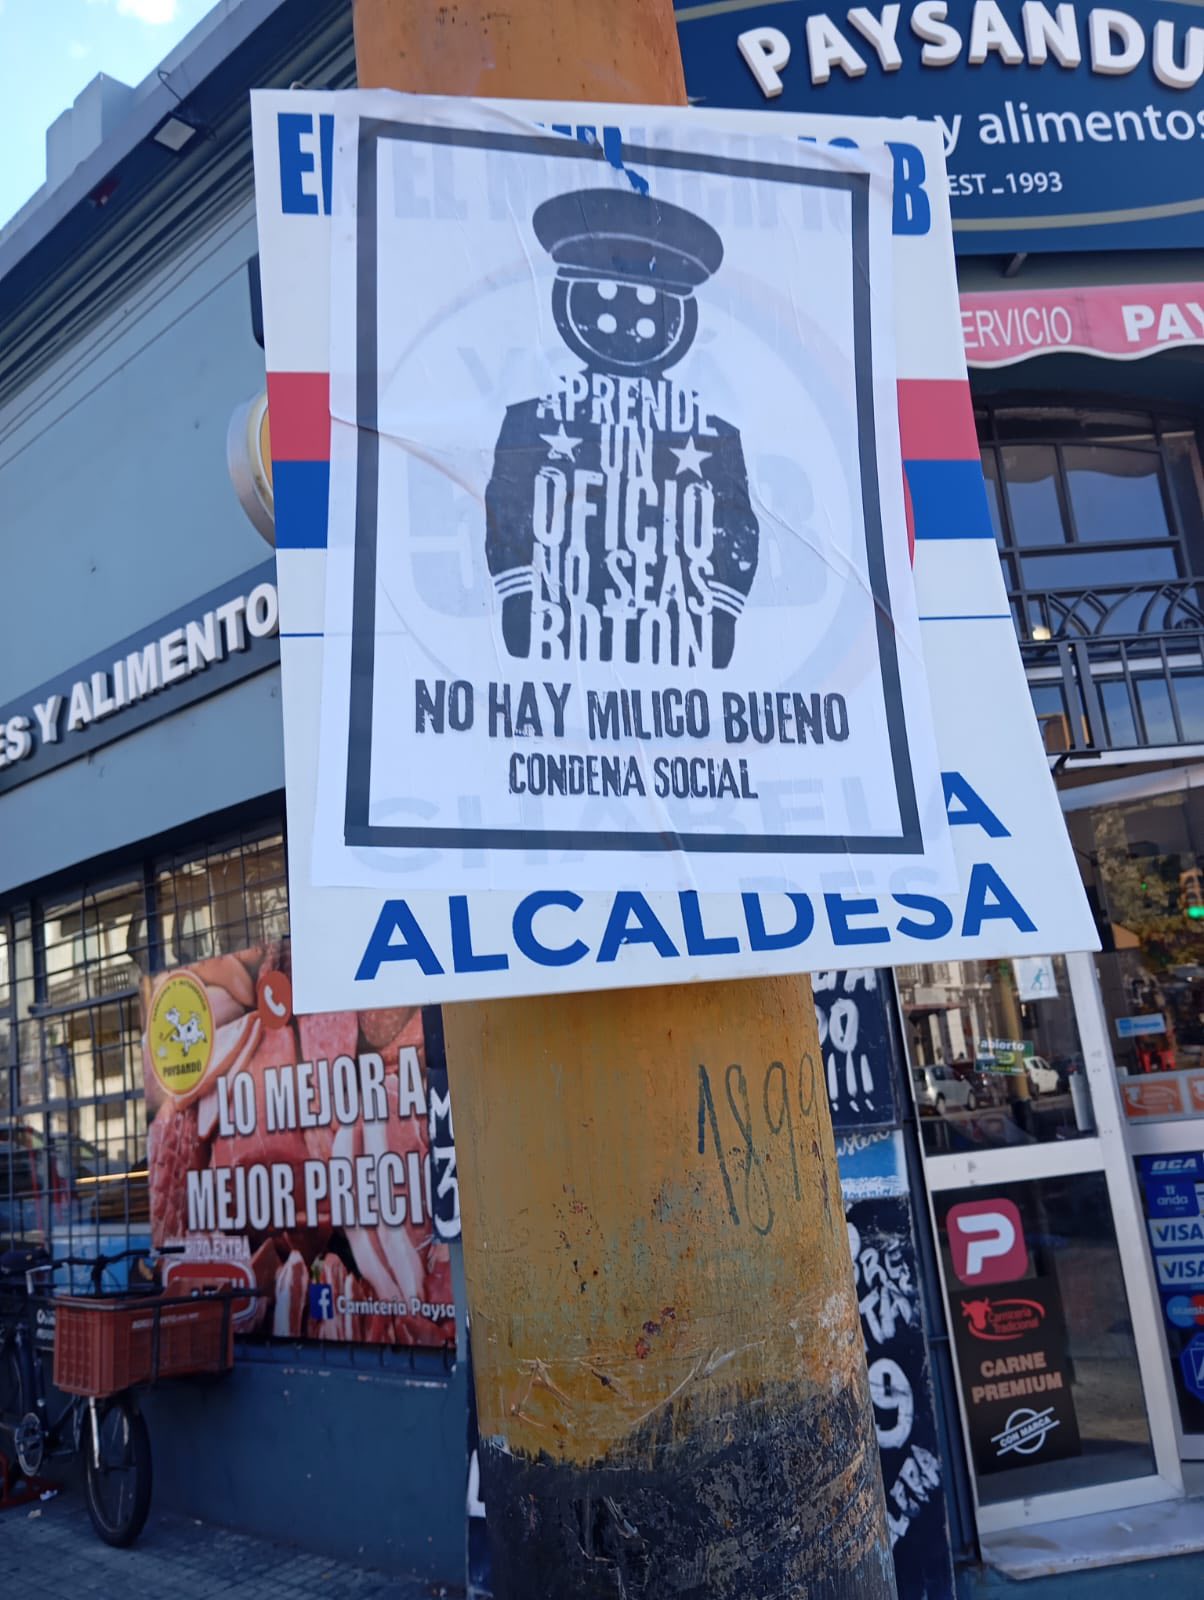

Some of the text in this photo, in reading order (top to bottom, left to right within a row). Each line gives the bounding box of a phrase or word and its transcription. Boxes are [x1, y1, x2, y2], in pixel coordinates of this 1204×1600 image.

[737, 0, 1204, 98] PAYSANDU
[886, 141, 932, 236] B
[600, 417, 654, 480] UN
[532, 466, 715, 560] OFICIO
[531, 542, 715, 617] NO SEAS
[33, 695, 62, 744] Y
[67, 582, 280, 733] ALIMENTO
[414, 678, 851, 745] NO HAY MILICO BUENO
[509, 752, 759, 799] CONDENA SOCIAL
[354, 862, 1037, 981] ALCALDESA
[216, 1044, 428, 1138] LO MEJOR A
[186, 1150, 434, 1232] MEJOR PRECI
[1155, 1223, 1204, 1242] VISA
[867, 1358, 913, 1448] 9
[971, 1371, 1063, 1404] PREMIUM
[980, 1352, 1047, 1378] CARNE
[1000, 1415, 1053, 1447] CON MARCA
